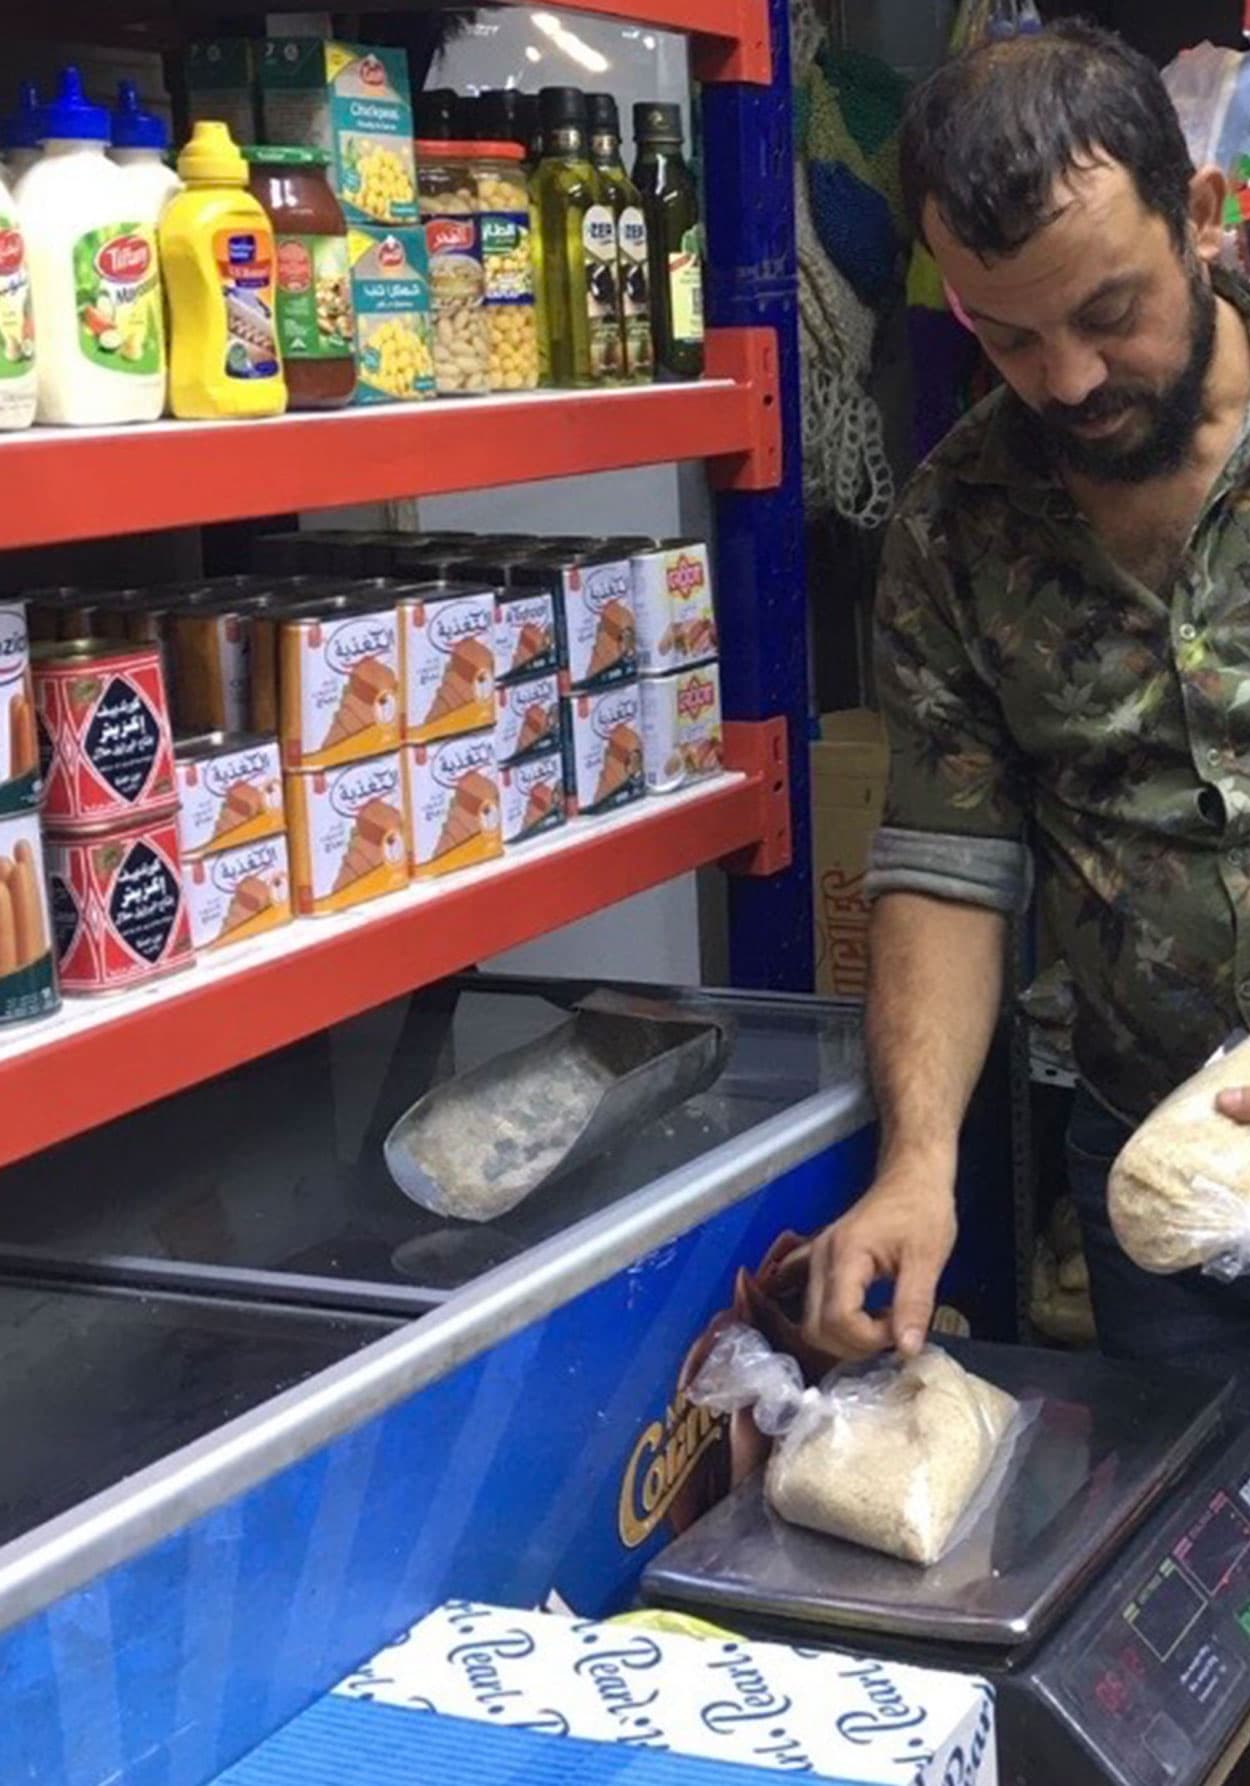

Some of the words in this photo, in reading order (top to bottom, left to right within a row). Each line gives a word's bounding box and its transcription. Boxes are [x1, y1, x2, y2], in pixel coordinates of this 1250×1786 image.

[447, 1628, 535, 1704] Pearl
[574, 1636, 662, 1716] Pearl
[700, 1653, 792, 1735] Pearl
[835, 1657, 928, 1745] Pearl
